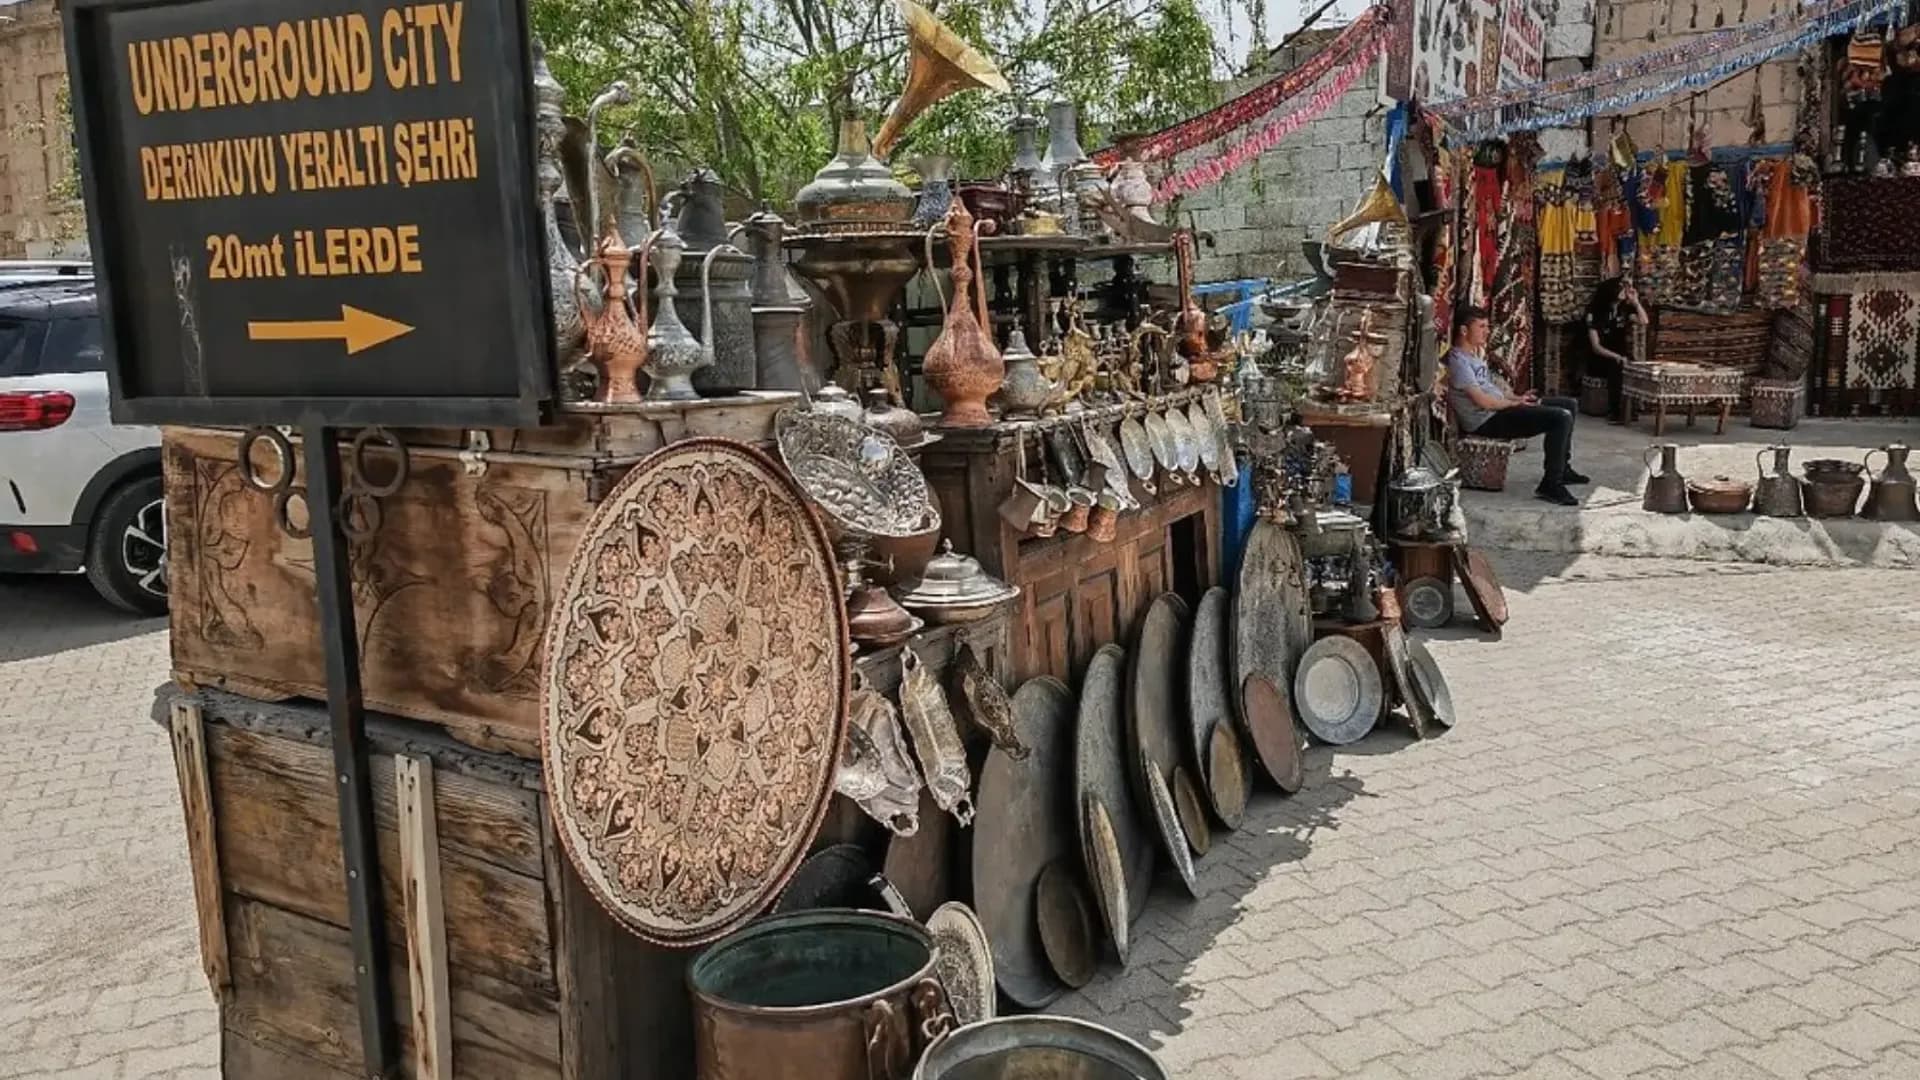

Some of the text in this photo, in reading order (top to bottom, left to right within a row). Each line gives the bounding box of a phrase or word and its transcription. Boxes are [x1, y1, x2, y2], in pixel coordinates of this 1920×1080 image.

[128, 13, 373, 115] UNDERGROUND
[281, 125, 389, 191] YERALTI
[206, 234, 287, 279] 20mt
